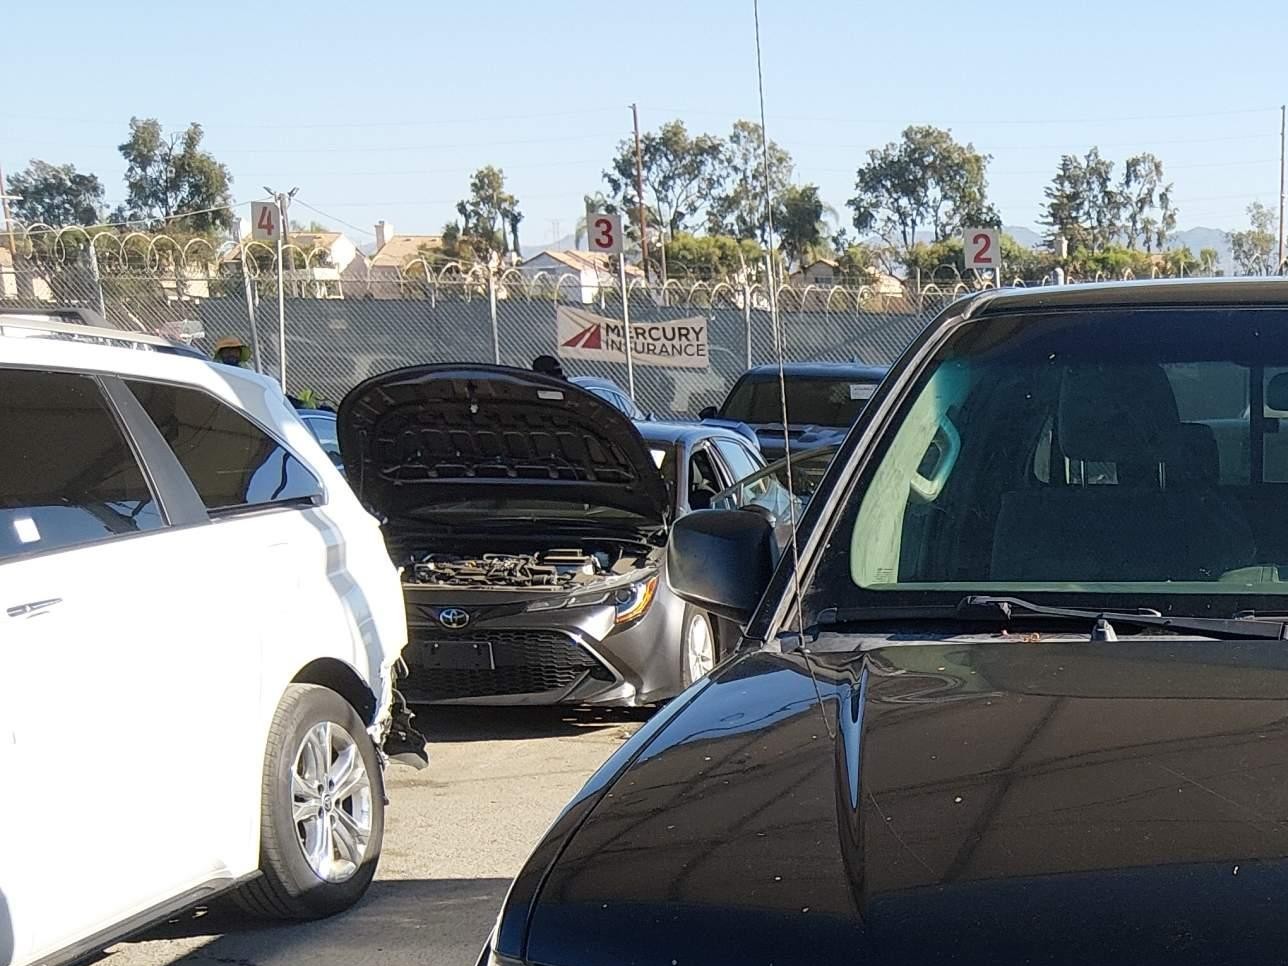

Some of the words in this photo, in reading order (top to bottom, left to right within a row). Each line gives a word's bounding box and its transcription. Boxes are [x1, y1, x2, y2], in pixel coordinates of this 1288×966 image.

[257, 206, 275, 236] 4
[595, 218, 613, 248] 3
[972, 233, 992, 263] 2
[605, 322, 704, 342] MERCURY
